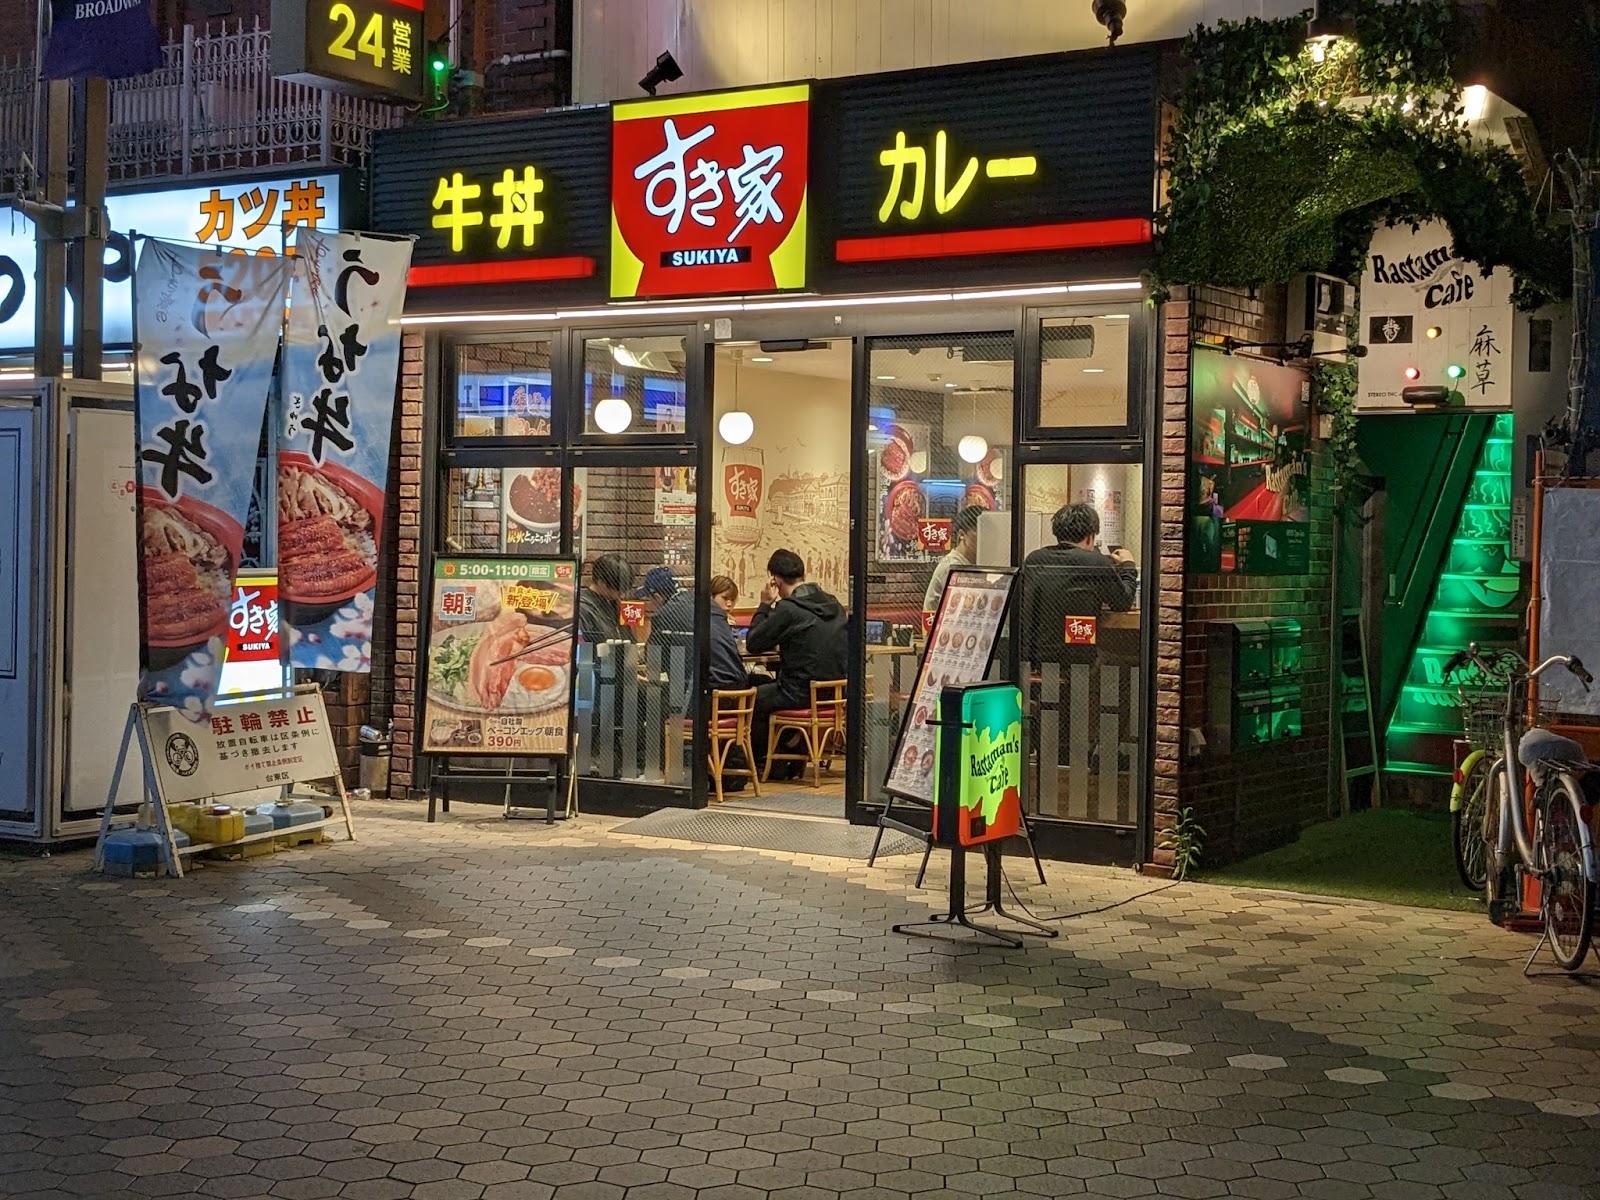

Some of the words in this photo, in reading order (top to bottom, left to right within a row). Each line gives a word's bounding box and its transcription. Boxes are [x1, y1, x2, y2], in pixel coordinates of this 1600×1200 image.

[328, 3, 386, 68] 24
[392, 18, 412, 75] 営業
[634, 118, 784, 243] すき家
[878, 130, 1037, 223] カレー
[195, 179, 326, 244] カツ丼
[432, 166, 544, 252] 牛丼
[671, 248, 739, 266] SUKIYA
[1371, 245, 1457, 285] Rastam
[1469, 324, 1501, 395] 麻草
[728, 466, 758, 505] すき家
[921, 522, 948, 542] すき家
[459, 564, 528, 576] 5:00-11:00
[442, 592, 465, 615] 朝
[465, 596, 475, 615] すき
[506, 594, 548, 609] 新登場
[623, 604, 642, 619] すき家
[1069, 619, 1093, 637] すき家
[242, 642, 271, 651] SUKIYA
[211, 706, 317, 736] 駐輪禁止
[487, 726, 564, 737] ベーコンエッグ朝食
[216, 728, 320, 749] 放置自転車は区条例に
[487, 736, 522, 747] 390円
[219, 742, 298, 761] 基づき撤去します
[969, 734, 1020, 777] Rastaman's
[265, 771, 290, 782] 台東区
